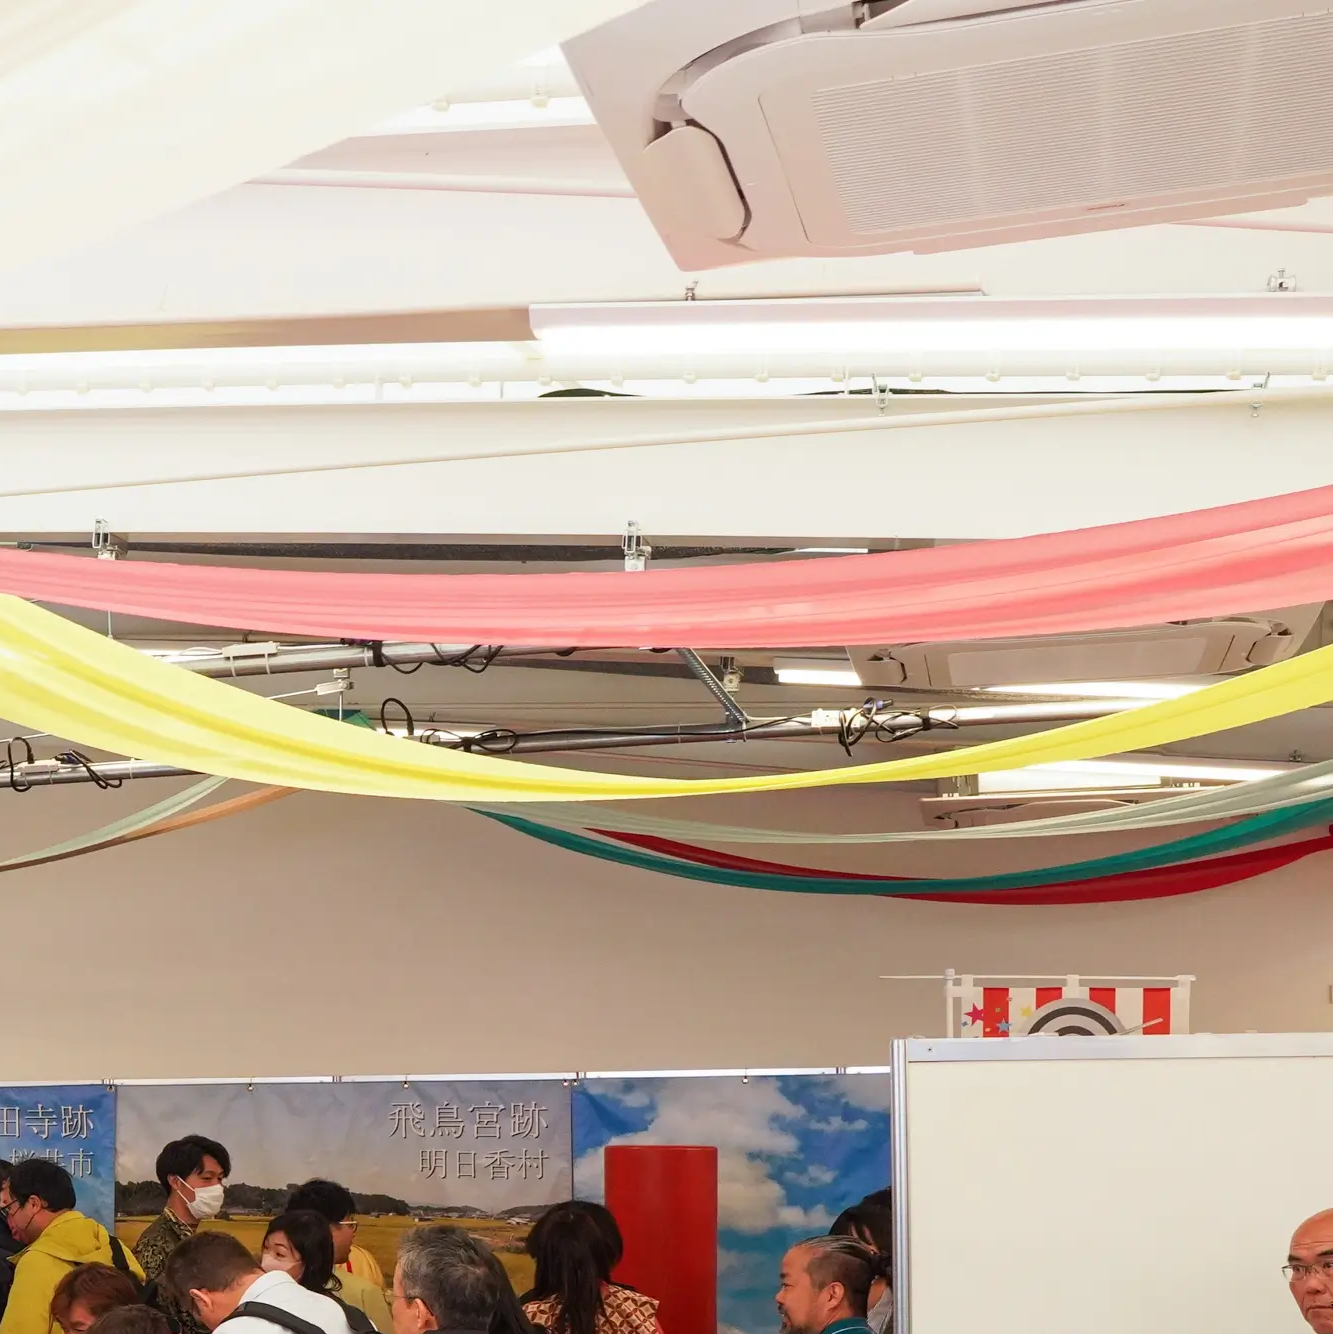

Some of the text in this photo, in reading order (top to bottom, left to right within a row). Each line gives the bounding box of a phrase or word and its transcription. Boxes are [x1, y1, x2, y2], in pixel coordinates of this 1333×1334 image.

[388, 1101, 549, 1140] 飛鳥宮跡
[418, 1147, 549, 1180] 明日香村
